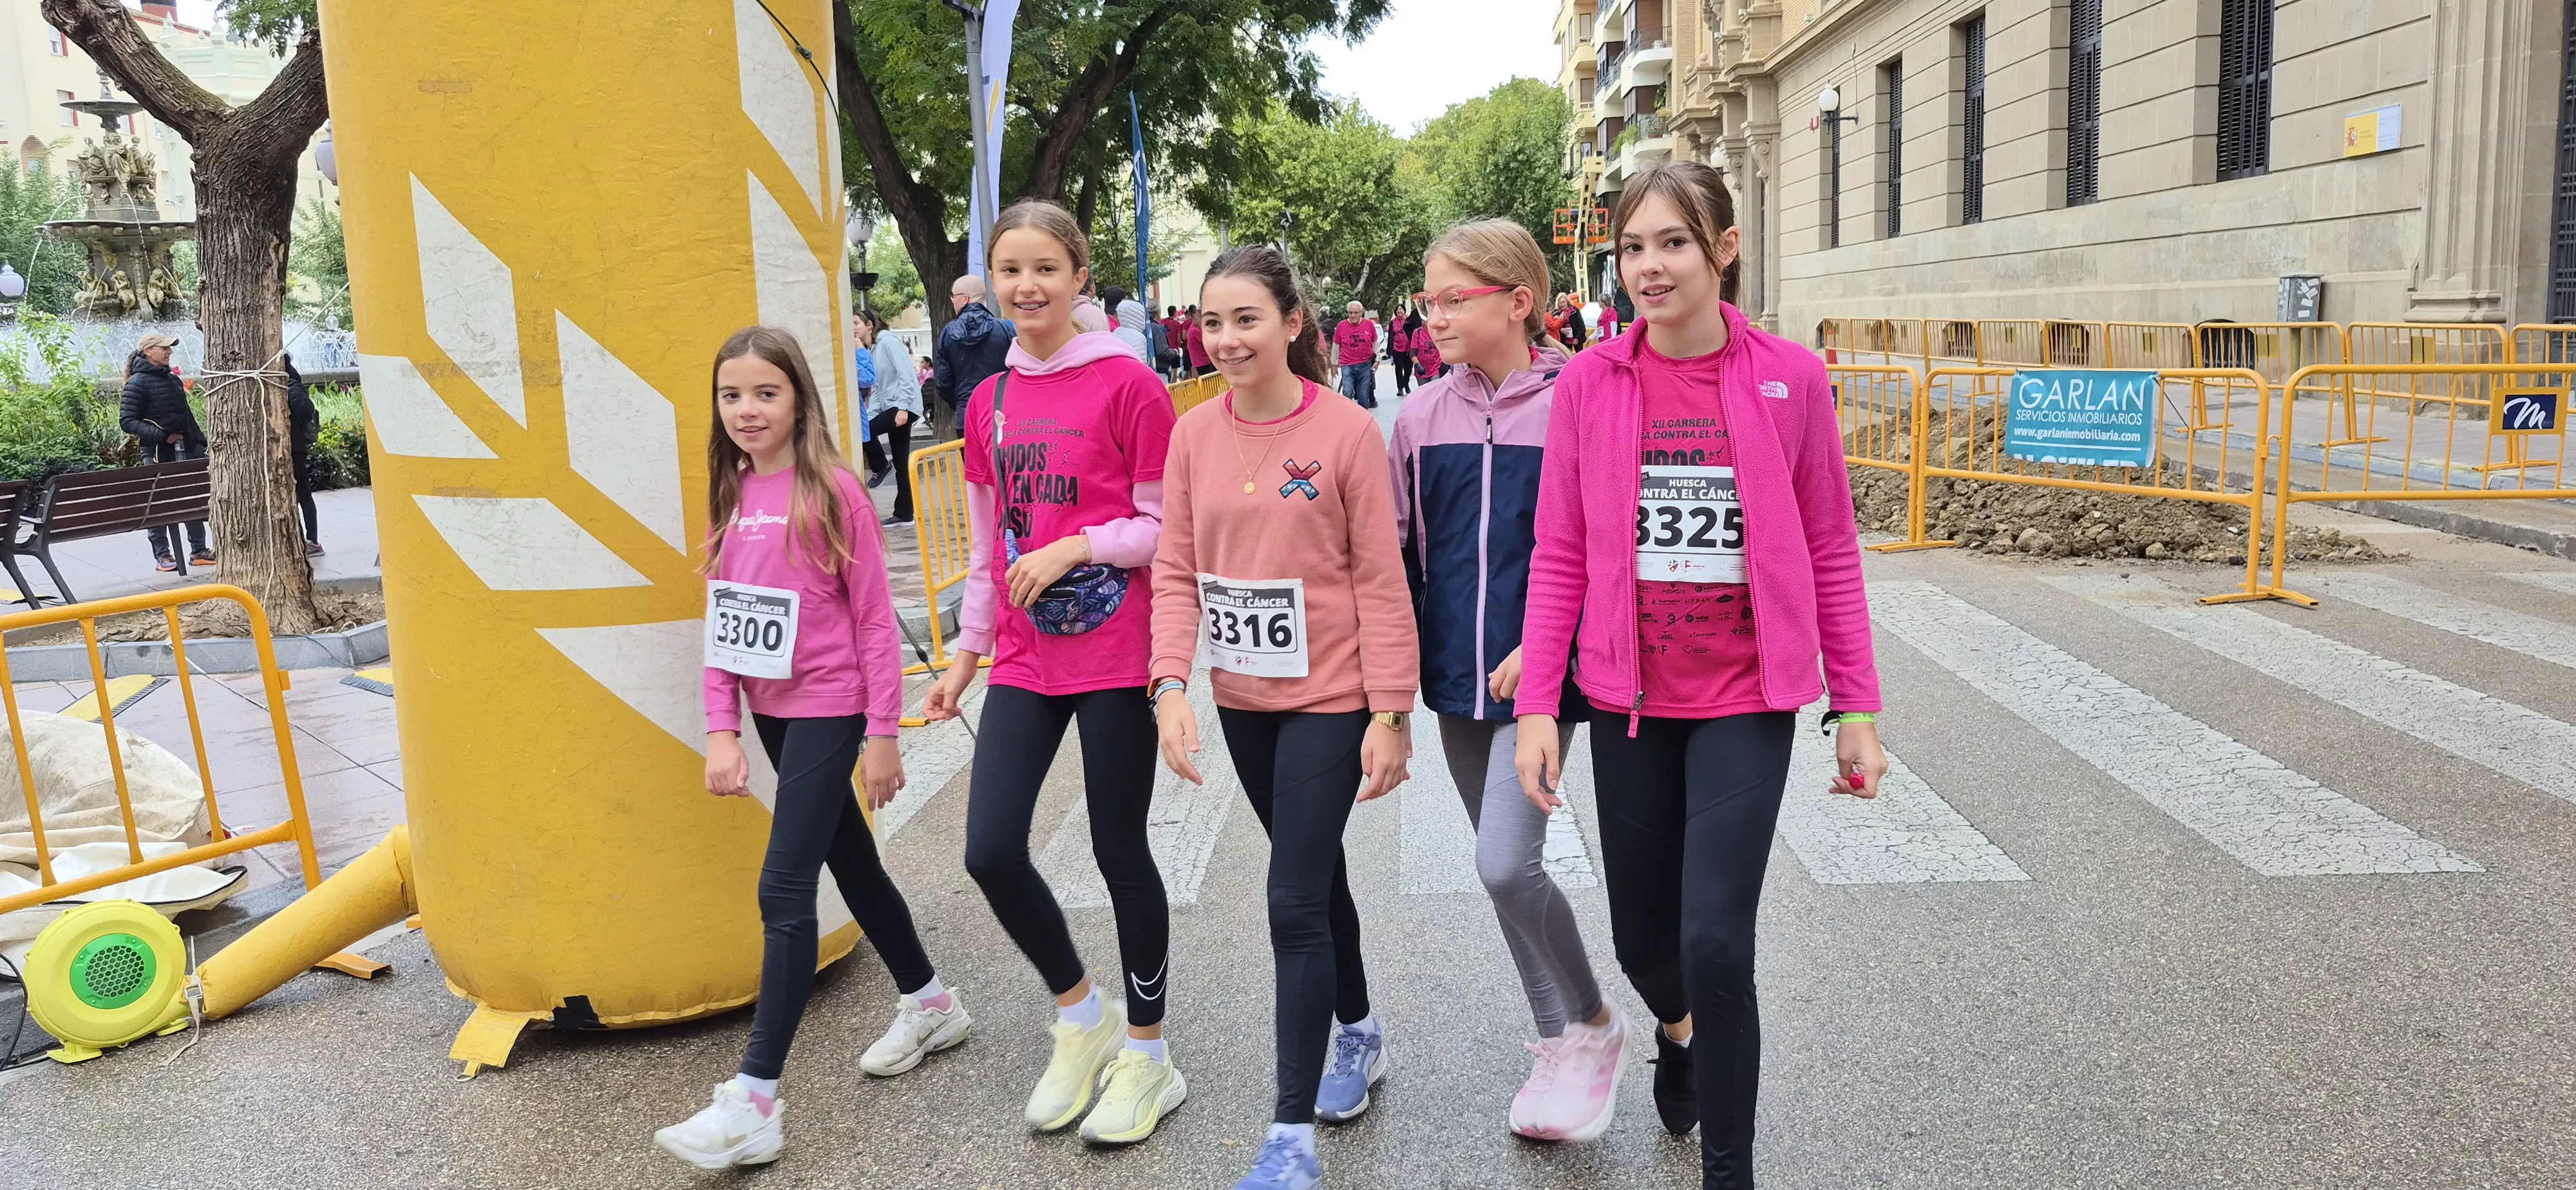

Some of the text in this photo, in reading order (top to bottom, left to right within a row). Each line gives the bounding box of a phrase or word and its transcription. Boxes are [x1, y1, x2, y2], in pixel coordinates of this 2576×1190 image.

[2019, 378, 2146, 411] GARLAN
[1652, 418, 1717, 429] XII CARRERA
[2016, 409, 2143, 425] SERVICIOS INMOBILIARIOS
[1654, 430, 1696, 440] CONTRA
[1699, 430, 1710, 439] EL
[2014, 426, 2141, 442] www.garlaninmobiliaria.com
[999, 442, 1047, 473] NIDOS
[1012, 474, 1078, 506] EN CADA
[1669, 479, 1707, 487] HUESCA
[1681, 490, 1696, 499] EL
[1699, 487, 1738, 500] CÁNC
[1206, 592, 1290, 608] CONTRA EL CÁNCER
[750, 601, 786, 616] CÁNCER
[717, 611, 783, 652] 3300
[1208, 607, 1293, 648] 3316
